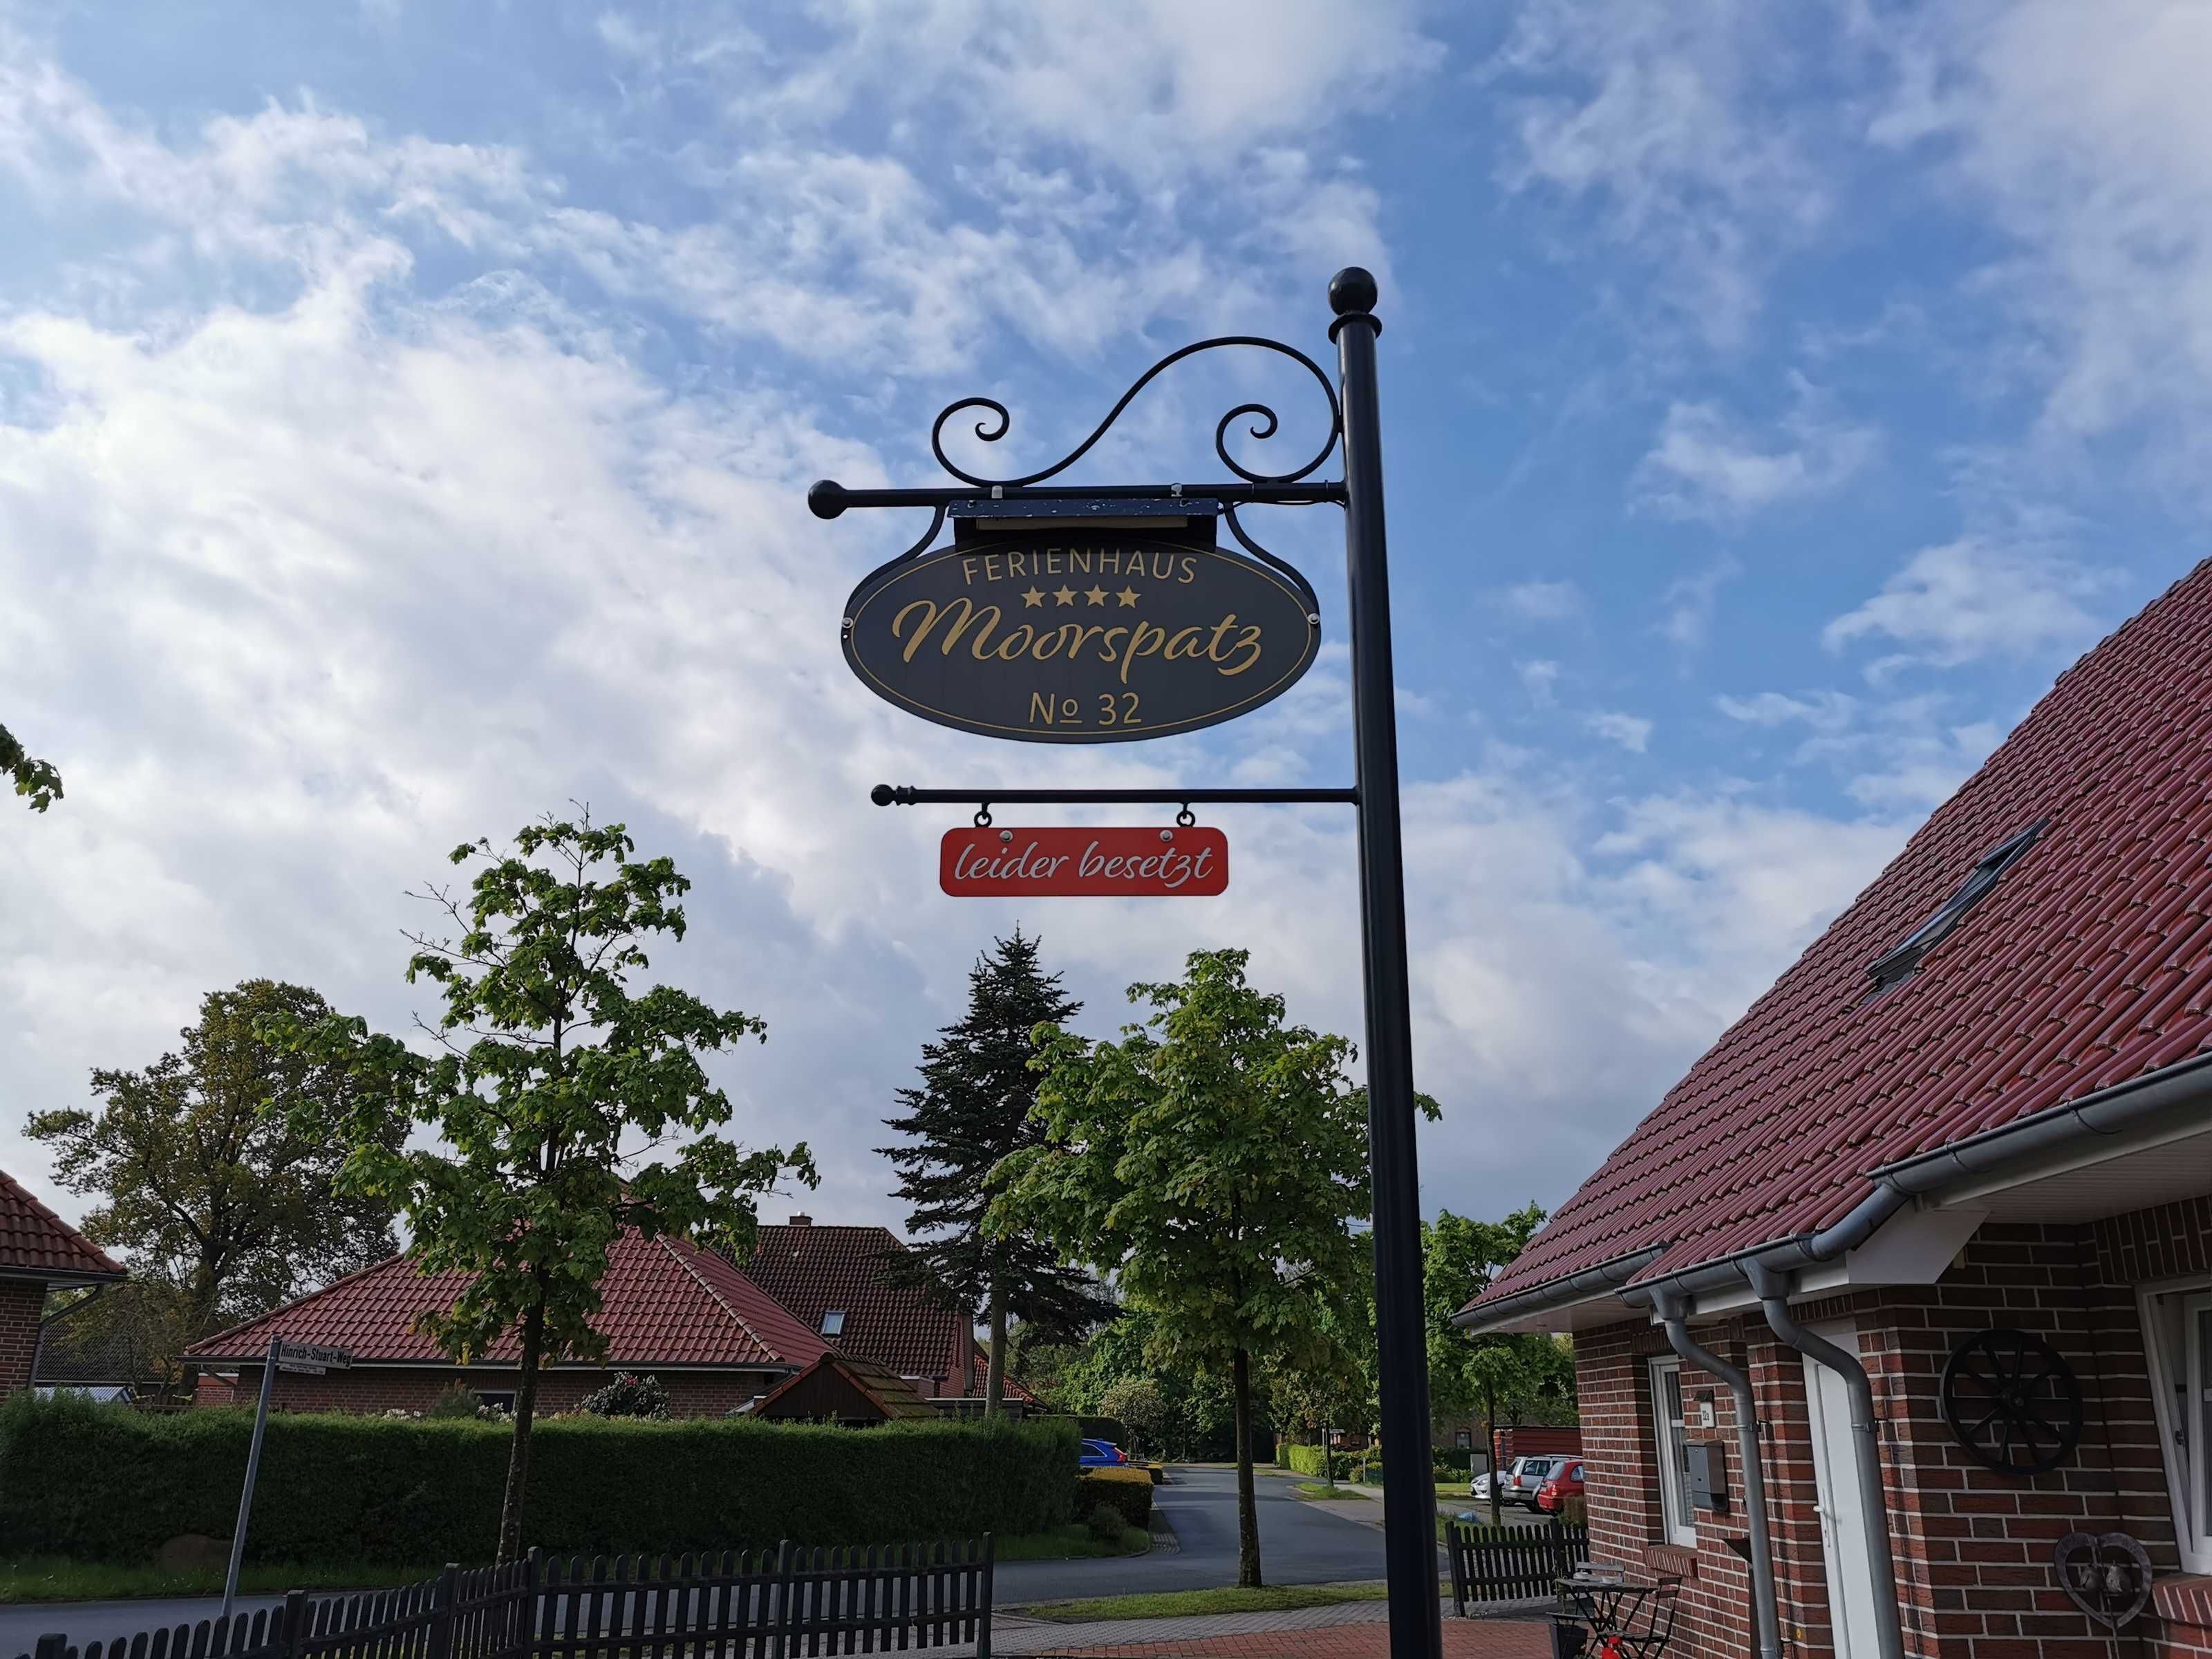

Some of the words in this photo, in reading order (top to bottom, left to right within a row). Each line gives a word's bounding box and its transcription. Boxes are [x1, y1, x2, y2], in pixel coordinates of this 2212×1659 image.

[962, 548, 1197, 585] FERIENHAUS
[892, 597, 1262, 684] Moorspatz
[1098, 692, 1142, 725] 32
[954, 841, 1070, 880] leider
[1078, 841, 1214, 888] besetzt
[281, 1343, 351, 1367] Hinrich-Stuart-Weg
